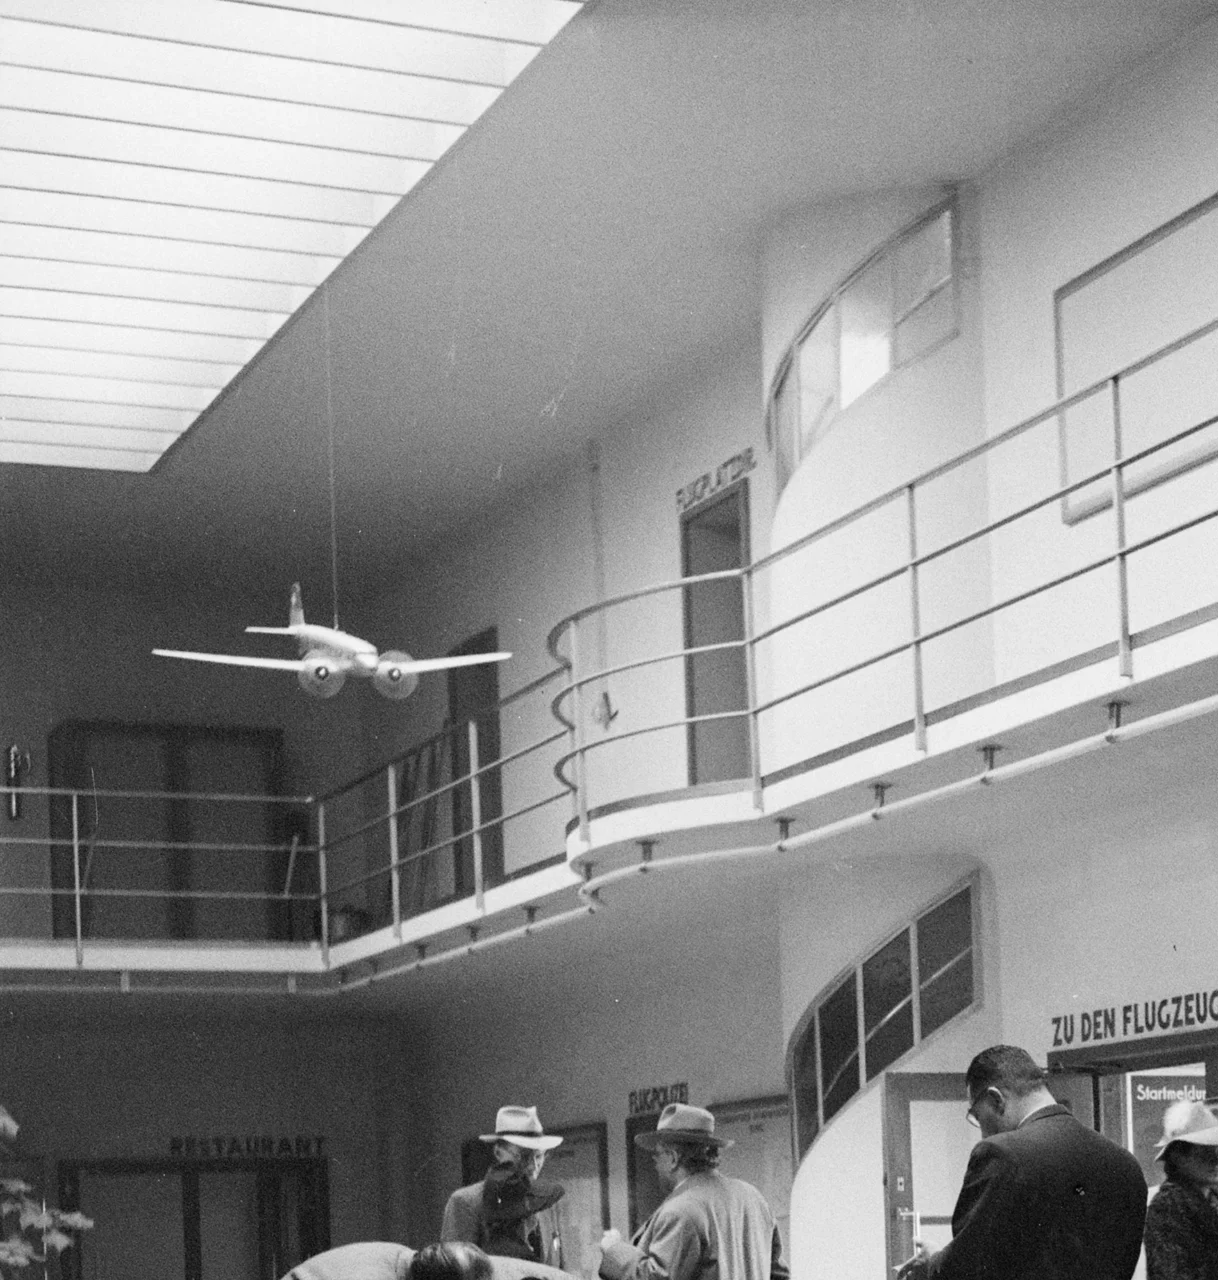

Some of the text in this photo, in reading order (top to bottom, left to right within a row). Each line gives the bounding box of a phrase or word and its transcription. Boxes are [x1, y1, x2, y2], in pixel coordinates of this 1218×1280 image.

[1051, 1015, 1075, 1047] ZU
[1081, 1008, 1116, 1041] DEN
[169, 1135, 326, 1155] RESTAURANT
